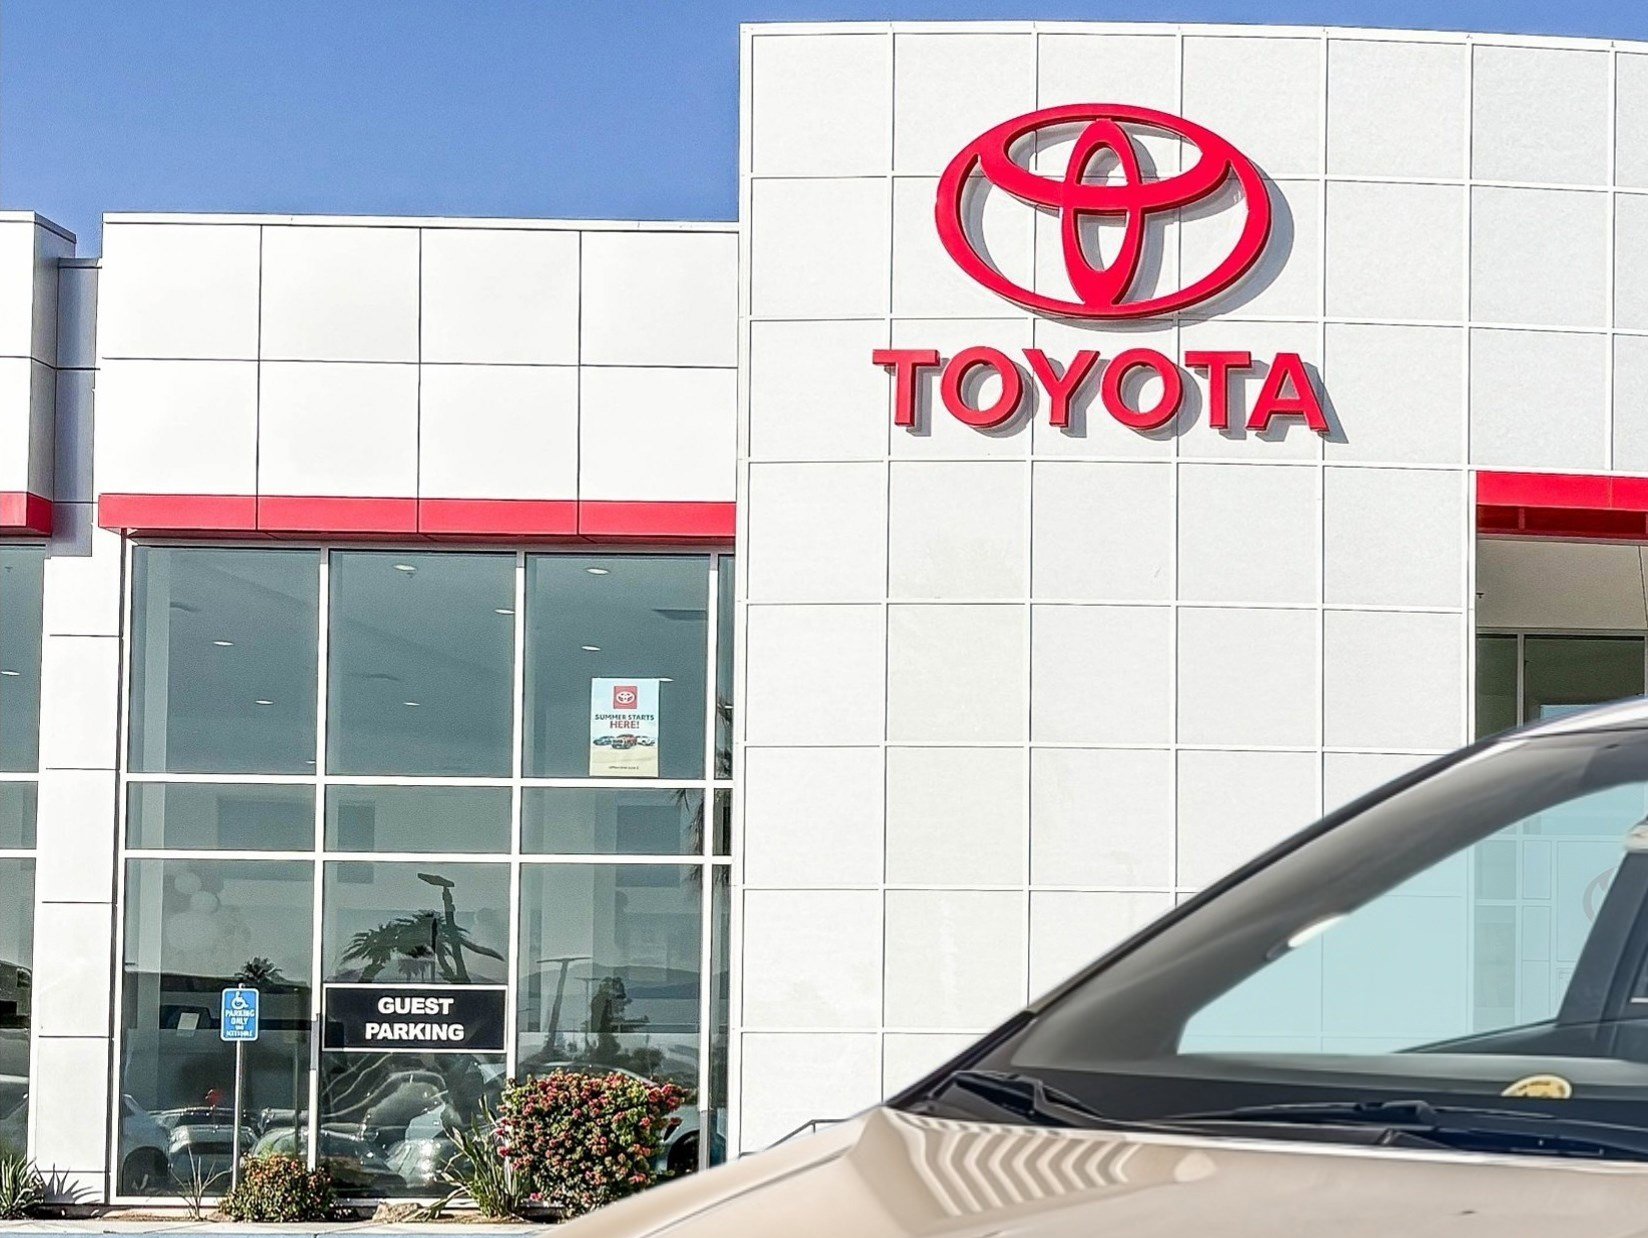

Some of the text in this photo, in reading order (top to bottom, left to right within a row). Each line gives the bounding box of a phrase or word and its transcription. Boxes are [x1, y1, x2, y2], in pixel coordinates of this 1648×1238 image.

[872, 346, 1329, 435] TOYOTA
[609, 720, 640, 729] HERE!
[377, 997, 455, 1015] GUEST
[365, 1022, 465, 1041] PARKING
